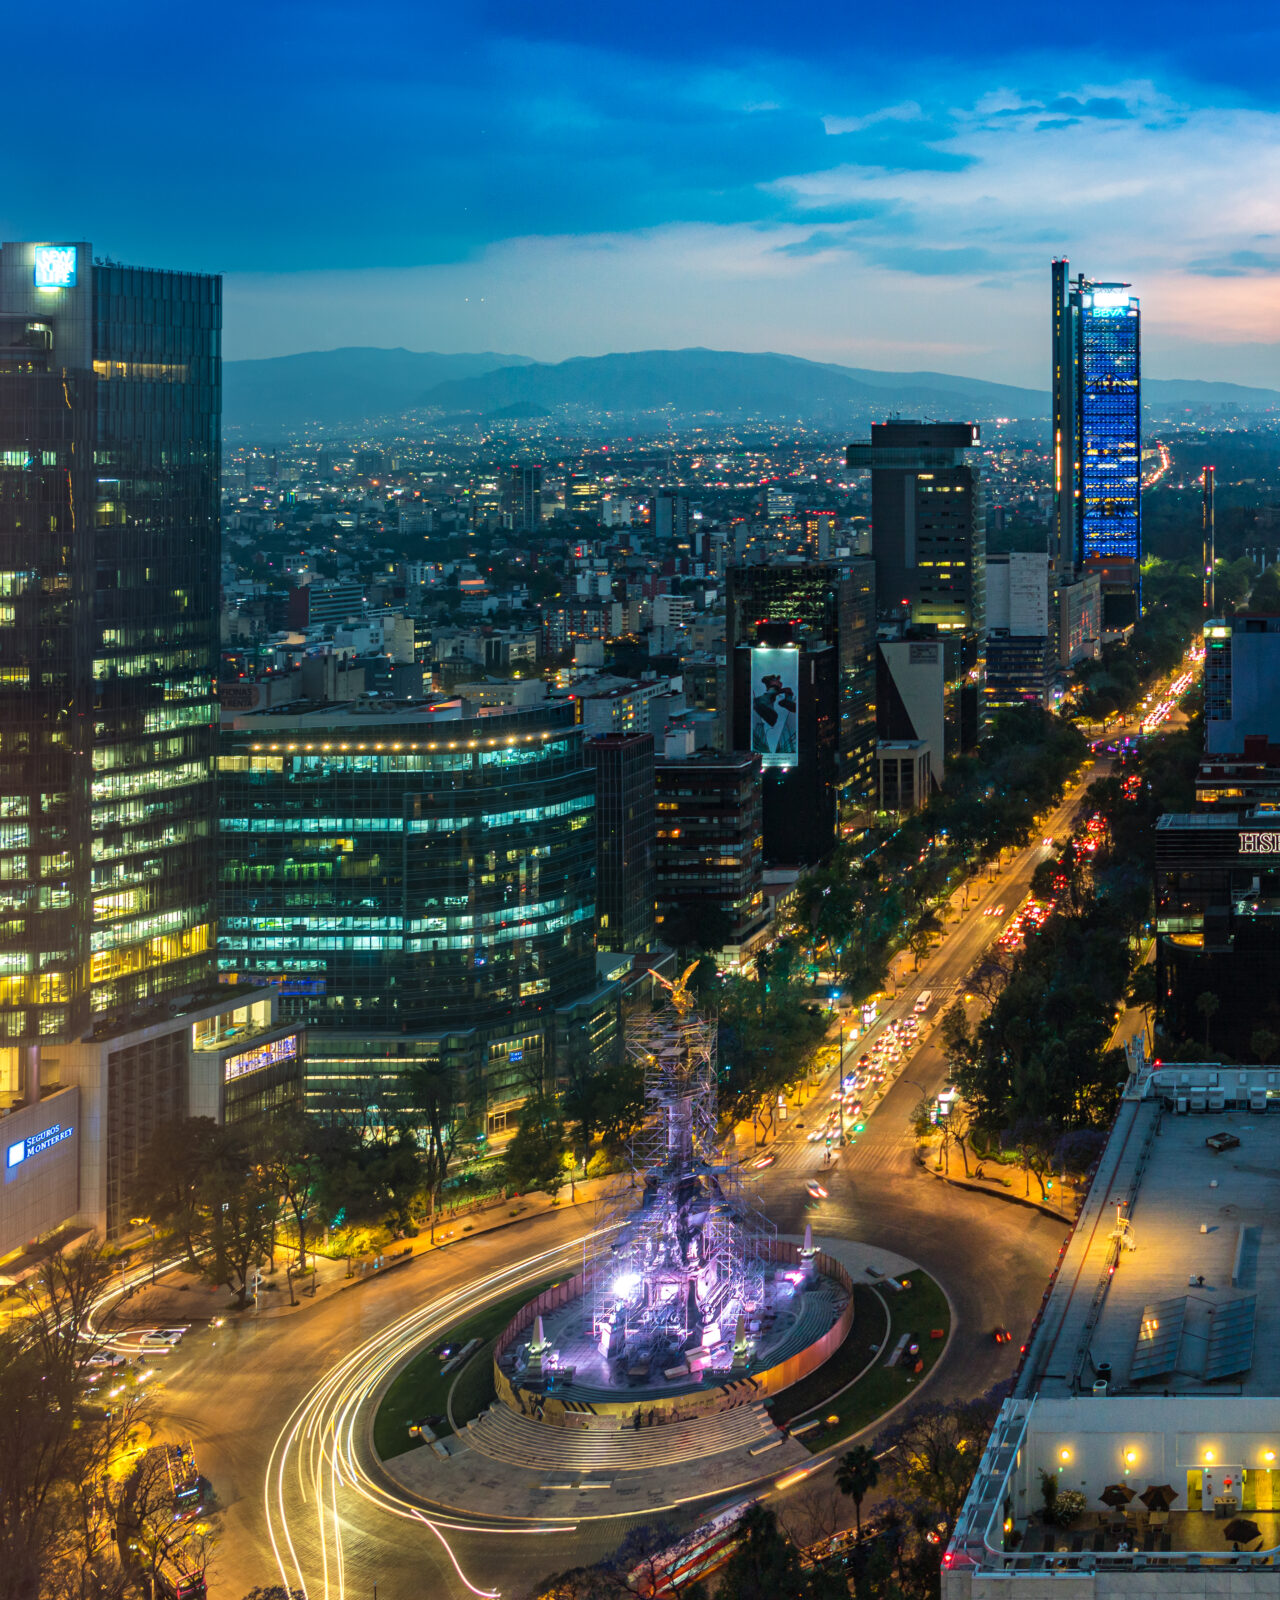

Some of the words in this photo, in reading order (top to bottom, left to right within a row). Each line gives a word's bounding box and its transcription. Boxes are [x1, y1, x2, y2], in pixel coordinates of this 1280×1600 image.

[42, 250, 71, 261] NEW
[38, 260, 74, 272] YORK
[43, 272, 70, 283] LIFE
[1093, 307, 1126, 317] BBVA
[26, 1124, 60, 1147] SEGUROS
[26, 1127, 73, 1158] MONTERREY
